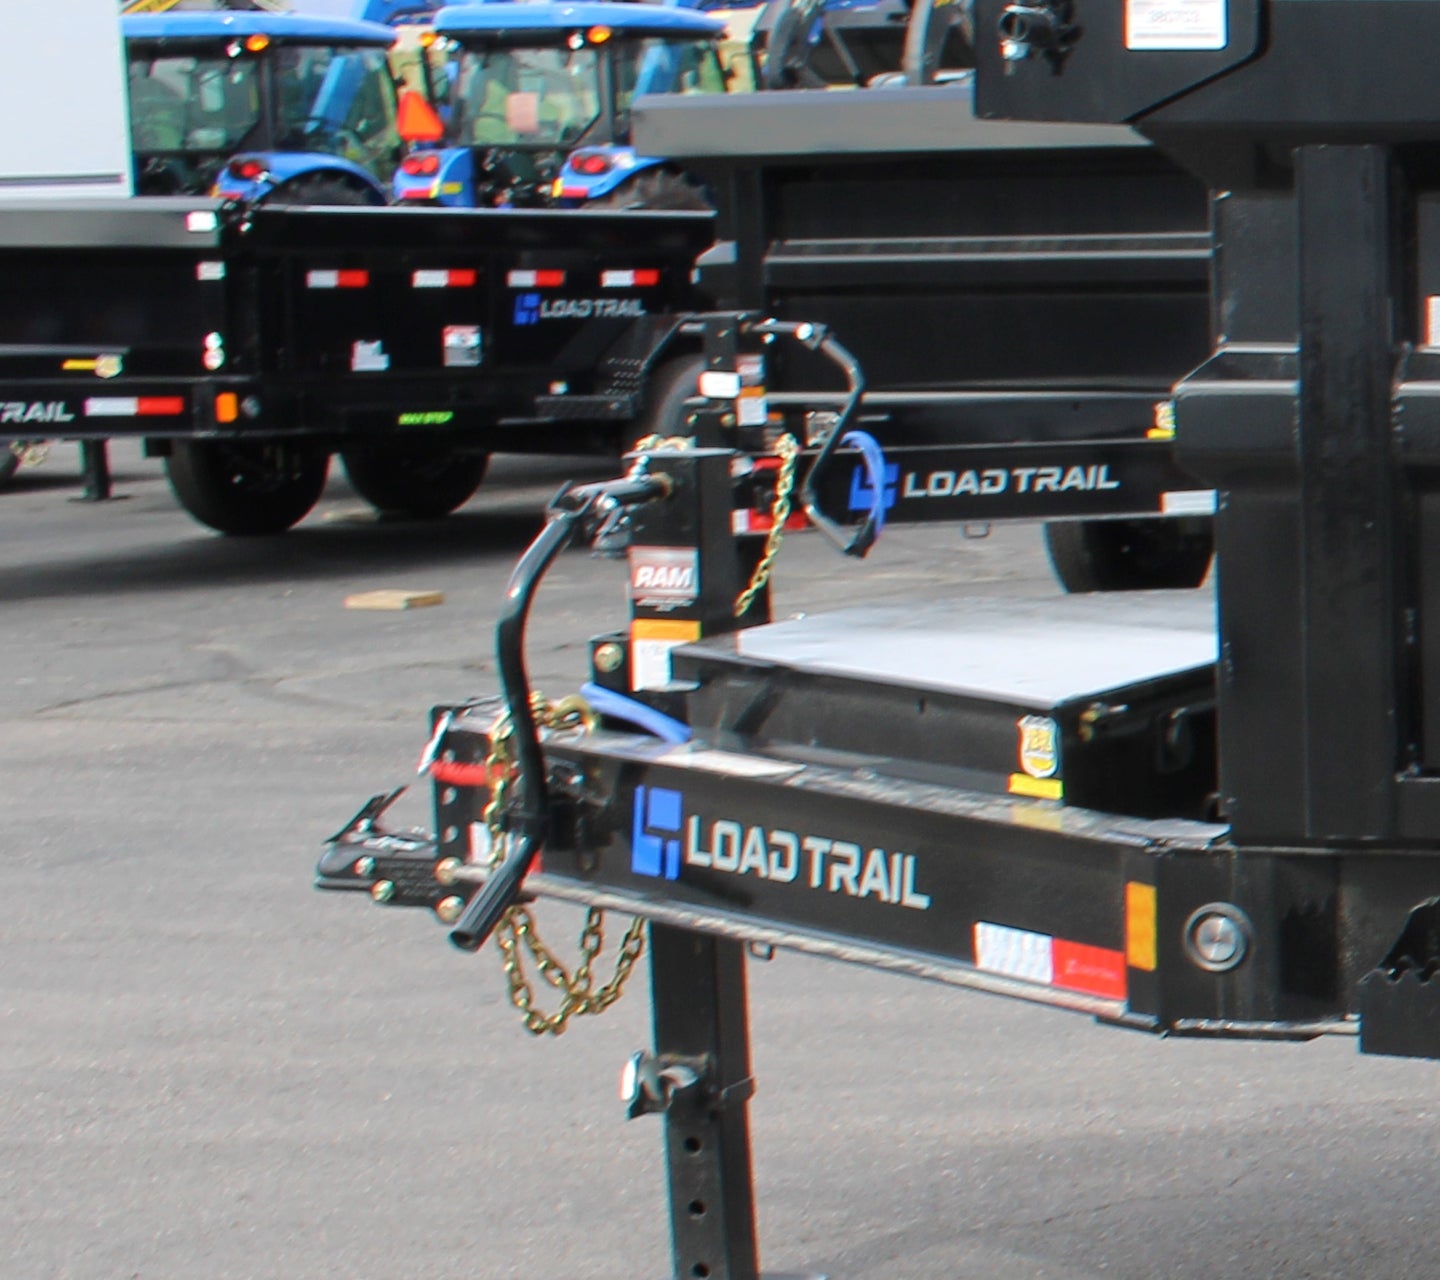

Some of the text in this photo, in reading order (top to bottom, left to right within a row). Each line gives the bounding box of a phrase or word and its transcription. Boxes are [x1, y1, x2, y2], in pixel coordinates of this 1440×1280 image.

[540, 299, 647, 318] LOAD TRAIL
[0, 401, 75, 422] RAIL
[904, 465, 1120, 498] LOAD TRAIL
[635, 565, 693, 589] RAM
[686, 815, 931, 910] LOAD TRAIL
